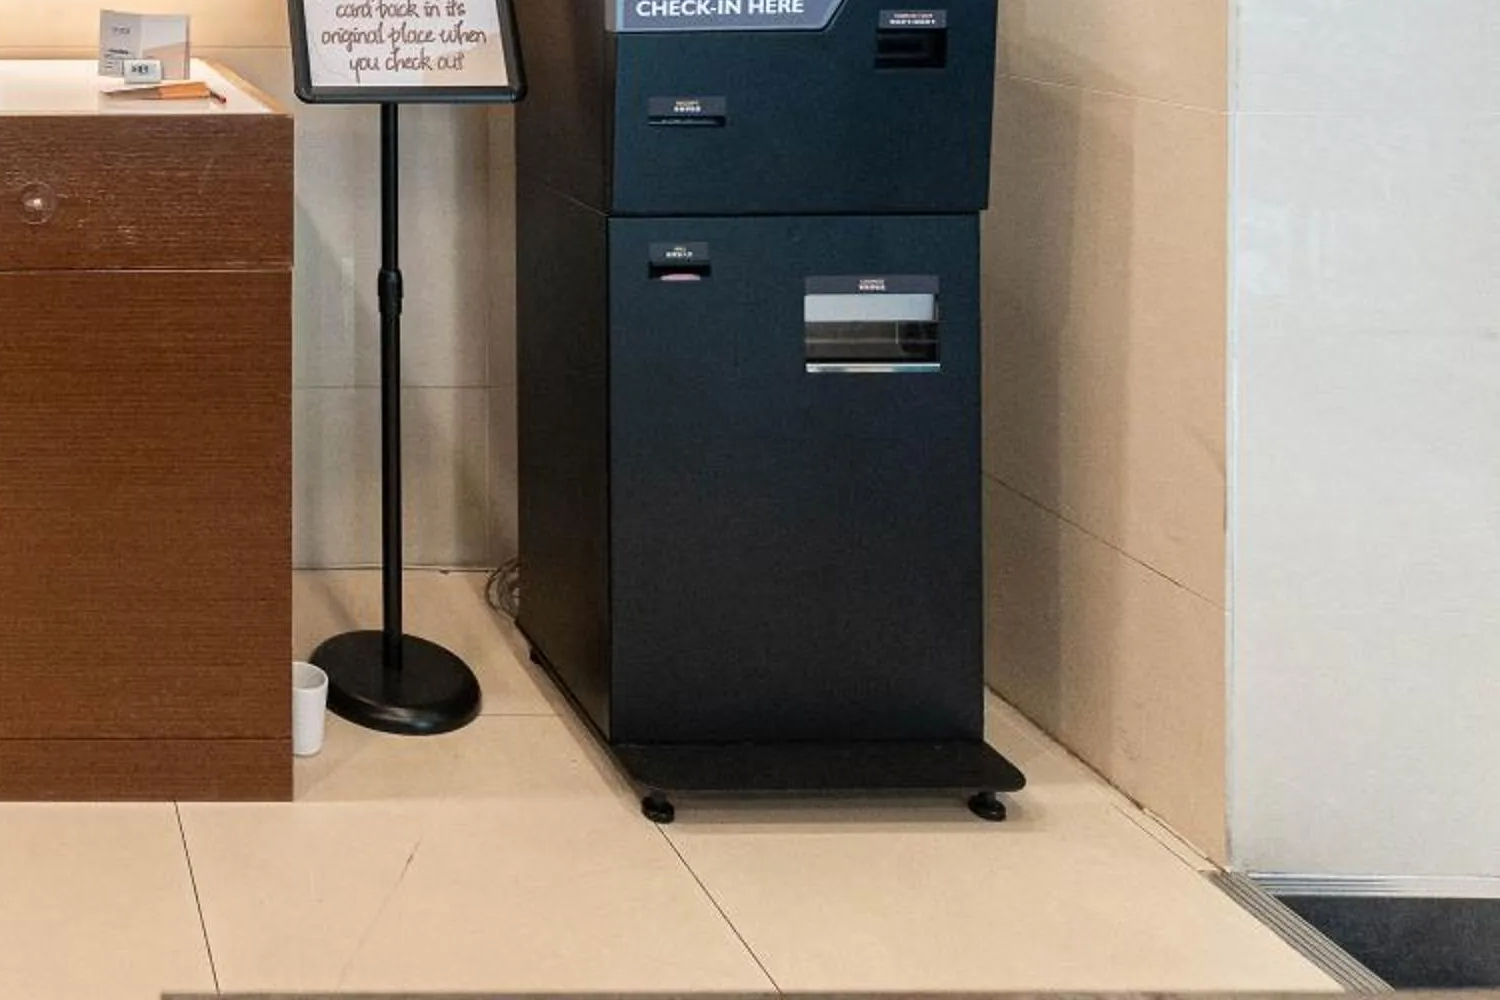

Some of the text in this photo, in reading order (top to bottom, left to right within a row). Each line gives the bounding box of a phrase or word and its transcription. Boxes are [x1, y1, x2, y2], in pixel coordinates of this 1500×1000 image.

[335, 1, 373, 18] card
[423, 0, 440, 17] in
[321, 20, 487, 52] original place when
[349, 48, 465, 83] you check out
